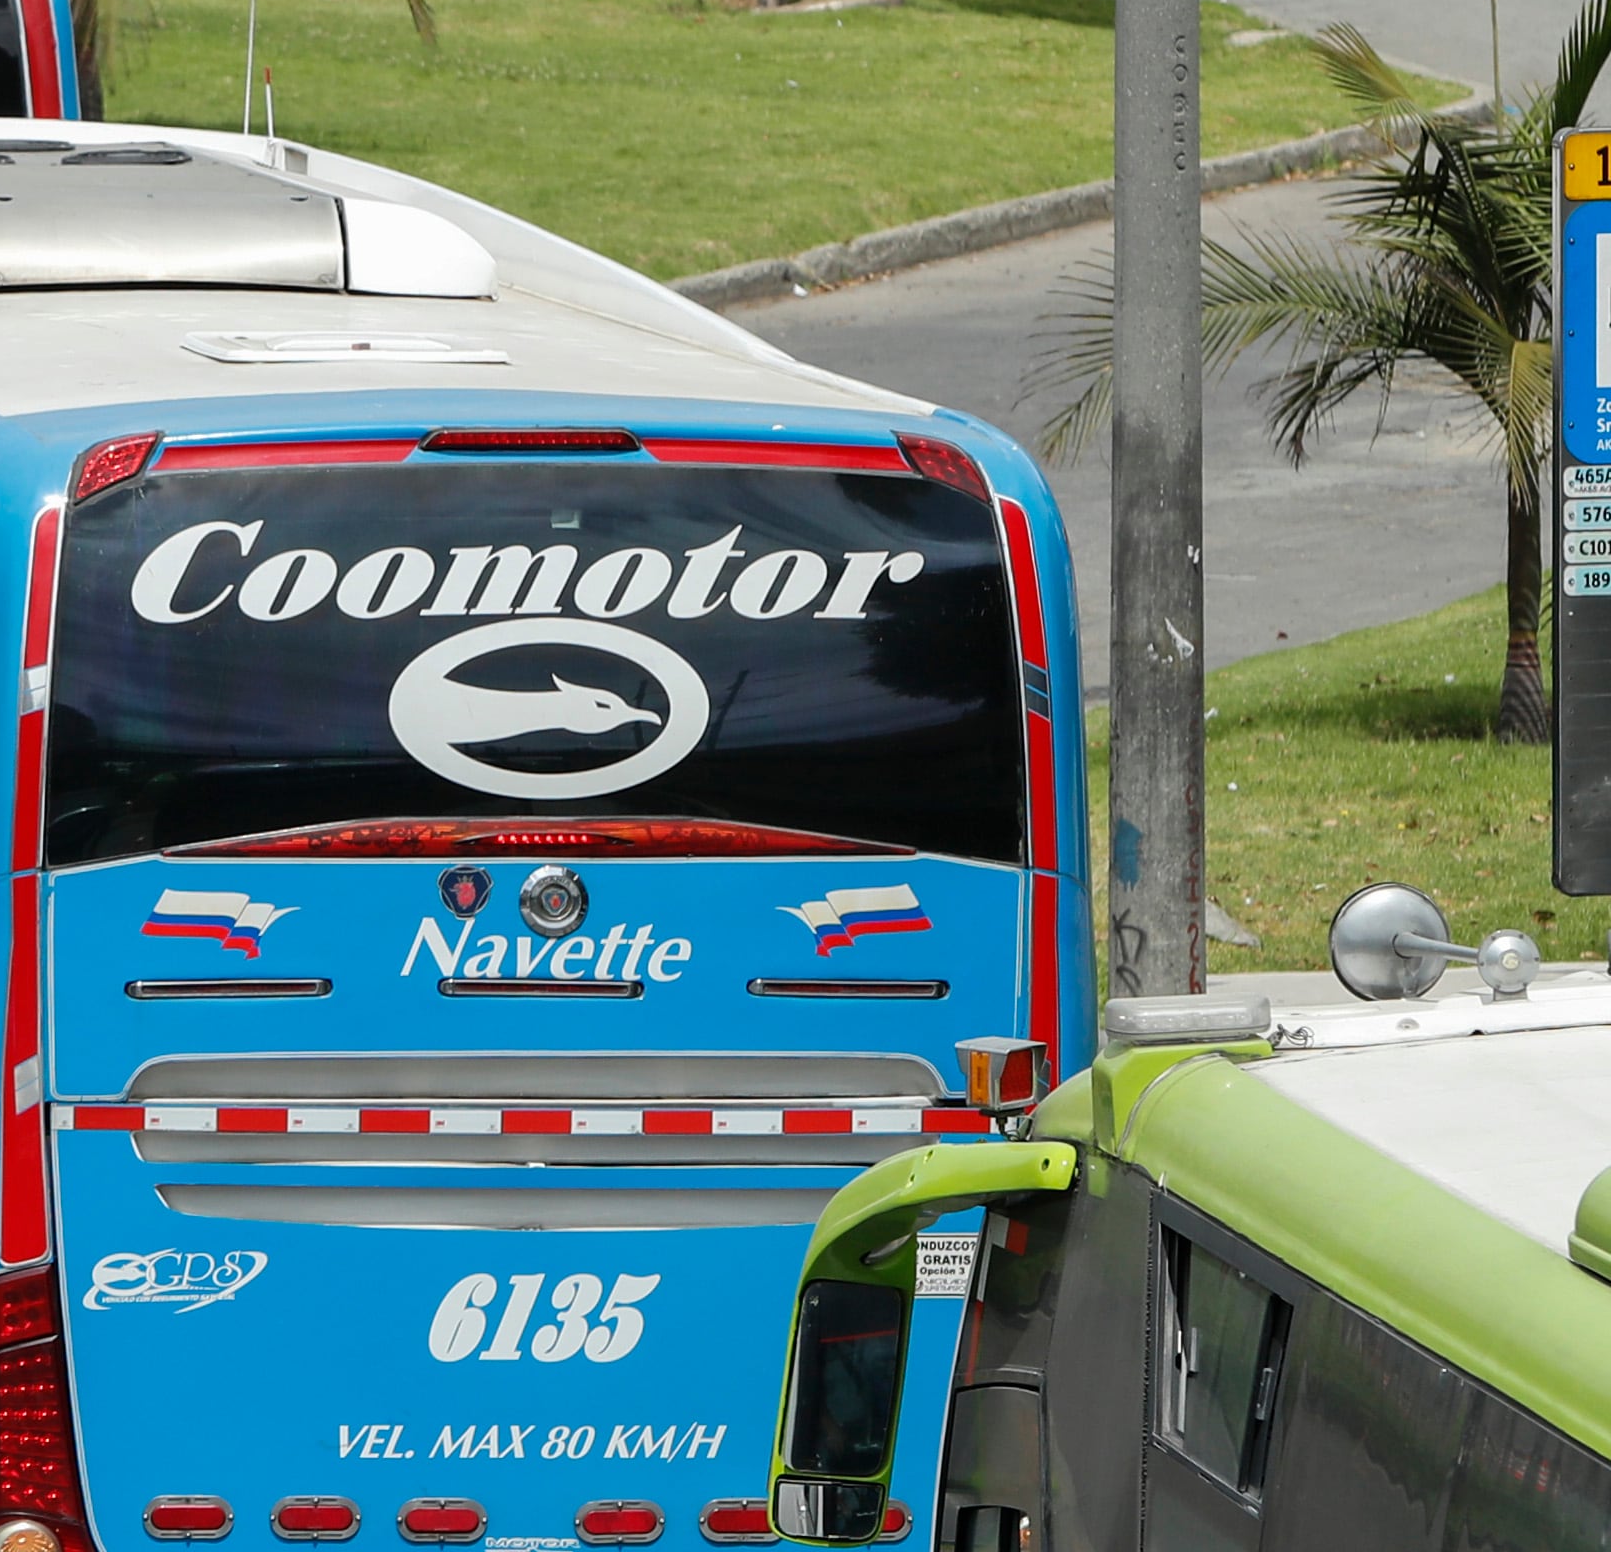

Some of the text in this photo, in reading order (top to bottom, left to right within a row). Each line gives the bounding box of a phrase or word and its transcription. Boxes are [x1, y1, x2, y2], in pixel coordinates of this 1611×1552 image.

[130, 519, 925, 626] Coomotor
[400, 916, 693, 985] Navette
[917, 1241, 977, 1252] NDUZCO?
[923, 1254, 971, 1265] GRATIS
[145, 1250, 244, 1289] GPS
[920, 1266, 966, 1276] Opción 3
[426, 1271, 661, 1364] 6135
[337, 1425, 727, 1459] VEL. MAX 80 KM/H
